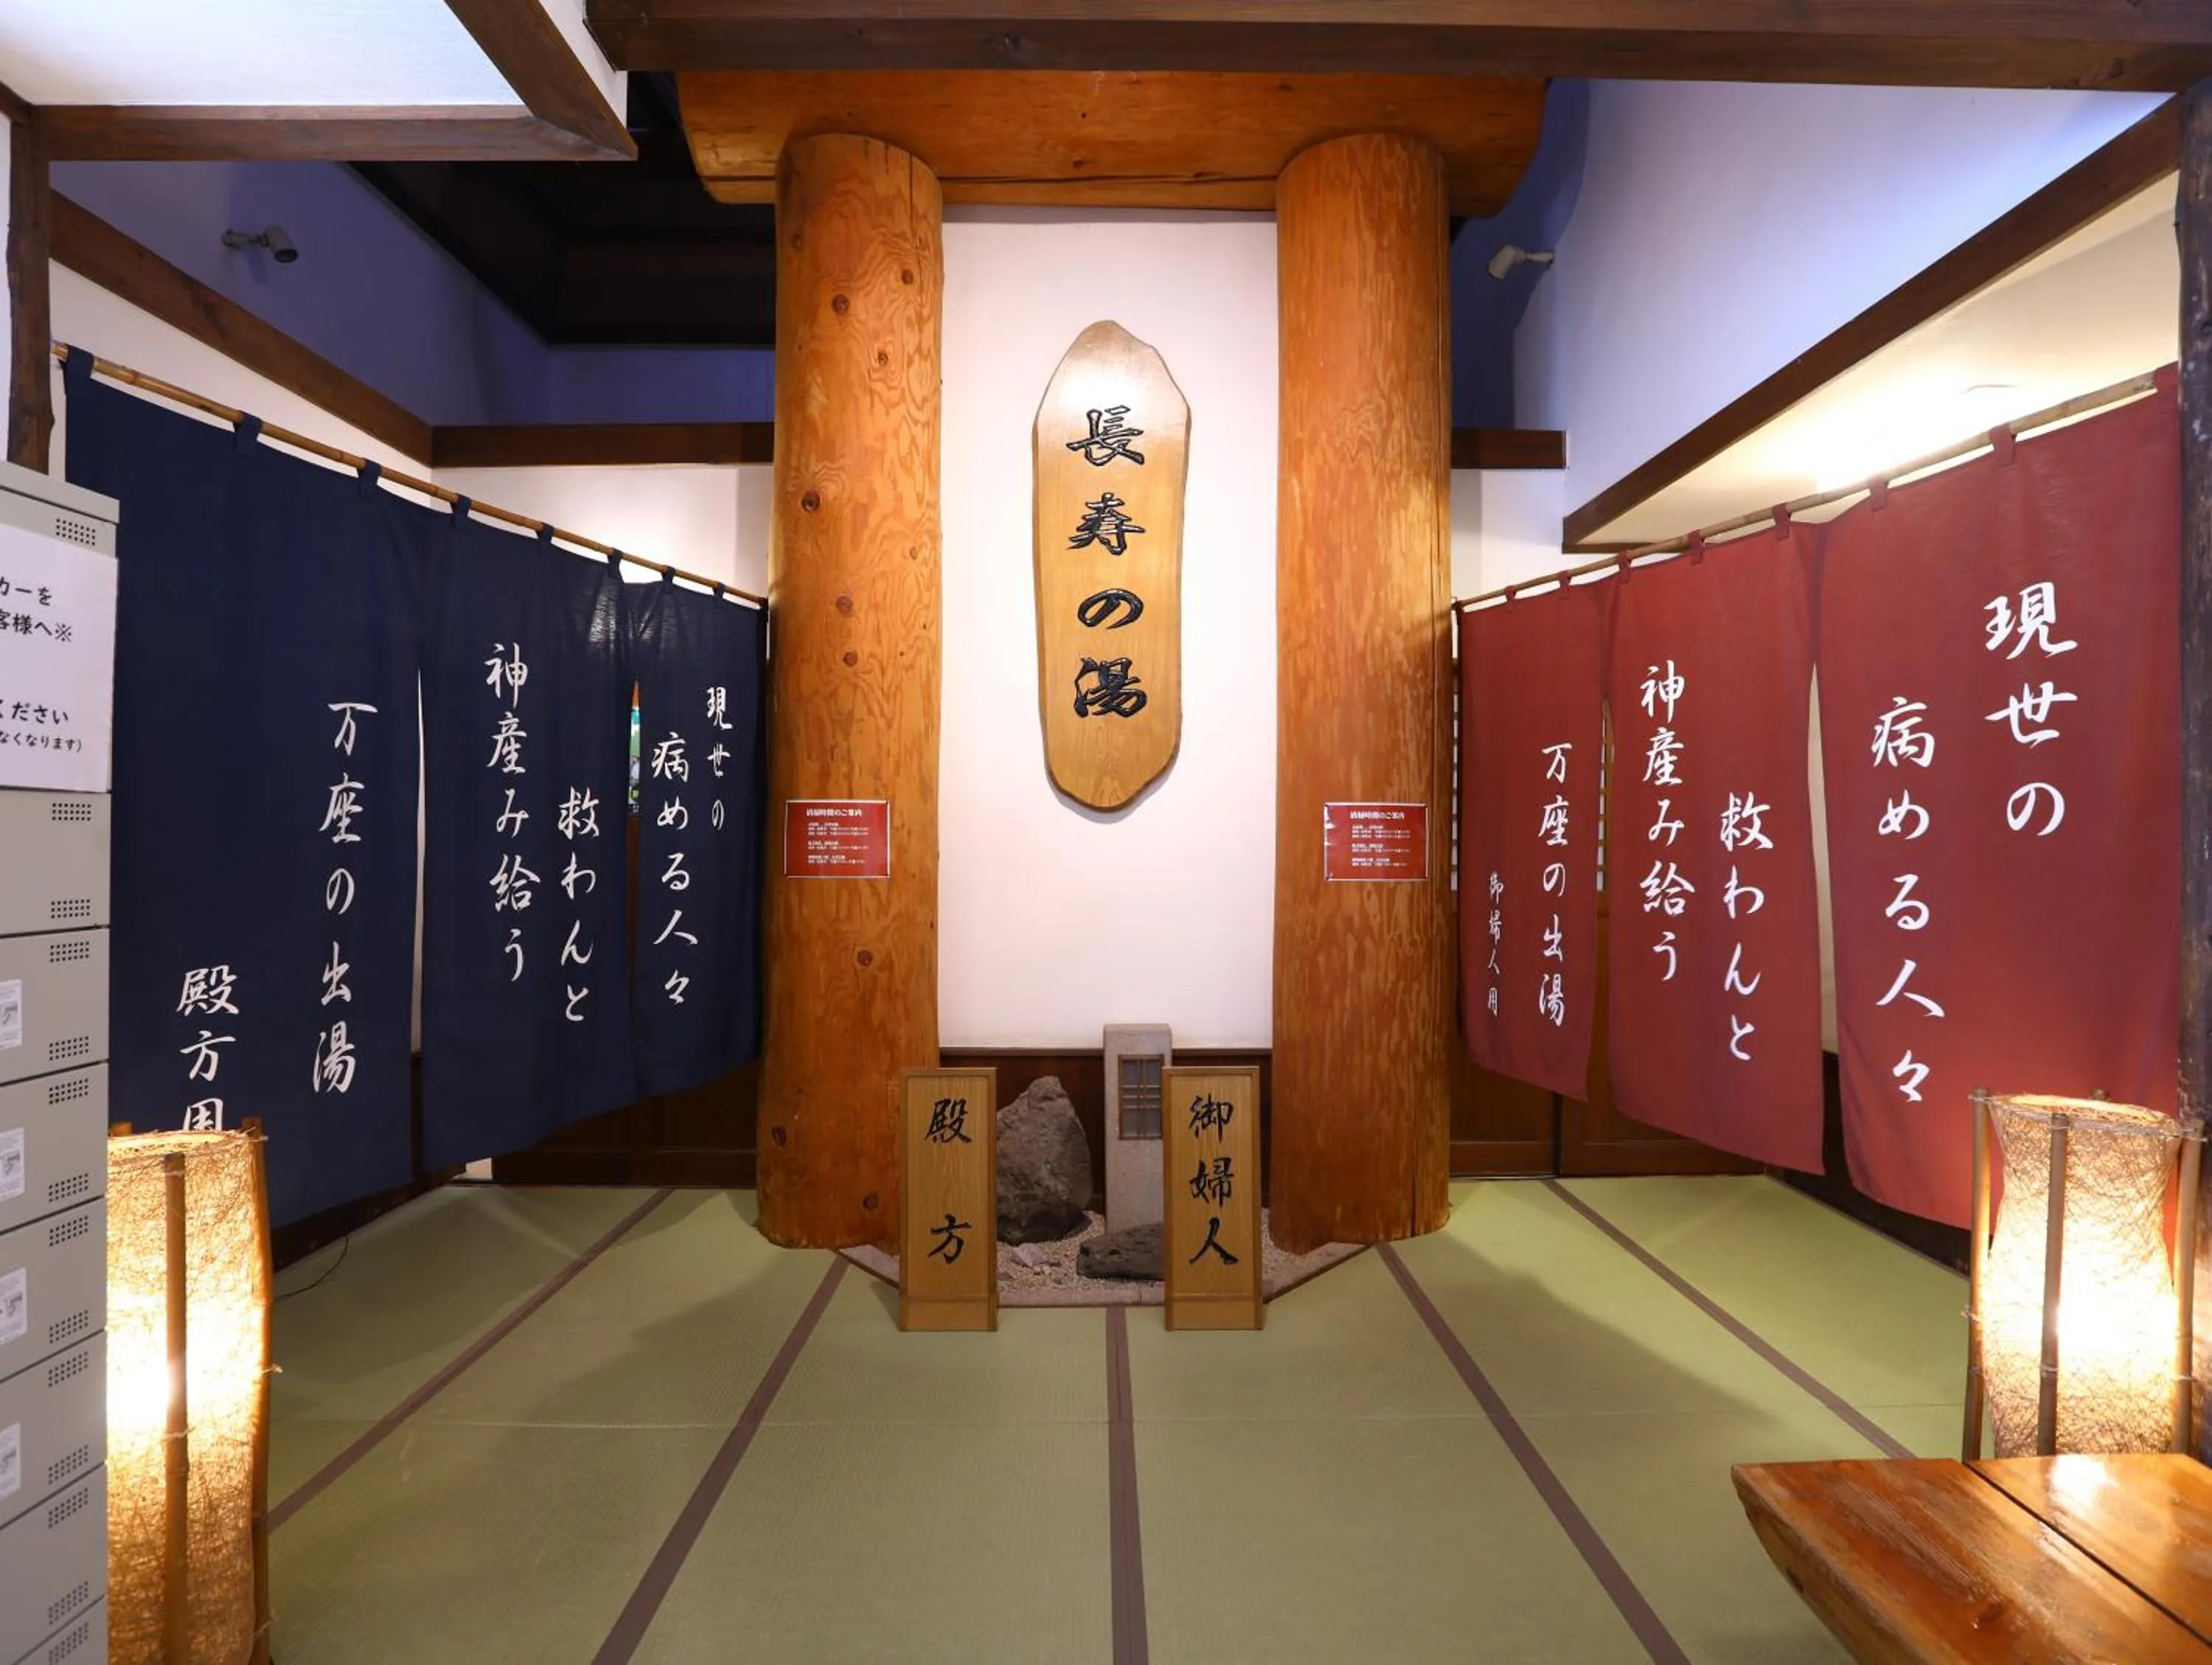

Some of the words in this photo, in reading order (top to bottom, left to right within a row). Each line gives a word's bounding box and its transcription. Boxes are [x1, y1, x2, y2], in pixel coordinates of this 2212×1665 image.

[1065, 404, 1147, 718] 長寿の湯
[0, 699, 69, 725] ださい
[484, 642, 540, 981] 神産み給う
[706, 686, 732, 830] 現世の
[1639, 659, 1695, 981] 神産み給う
[1983, 581, 2078, 836] 現世の
[313, 702, 378, 1094] 万座の出湯
[557, 786, 599, 1022] 救わんと
[651, 731, 698, 1004] 病める人々
[1538, 743, 1573, 1026] 万座の出湯
[1719, 791, 1774, 1060] 救わんと
[1871, 696, 1945, 1102] 病める人々
[925, 1098, 973, 1265] 殿方
[1189, 1094, 1239, 1266] 御婦人
